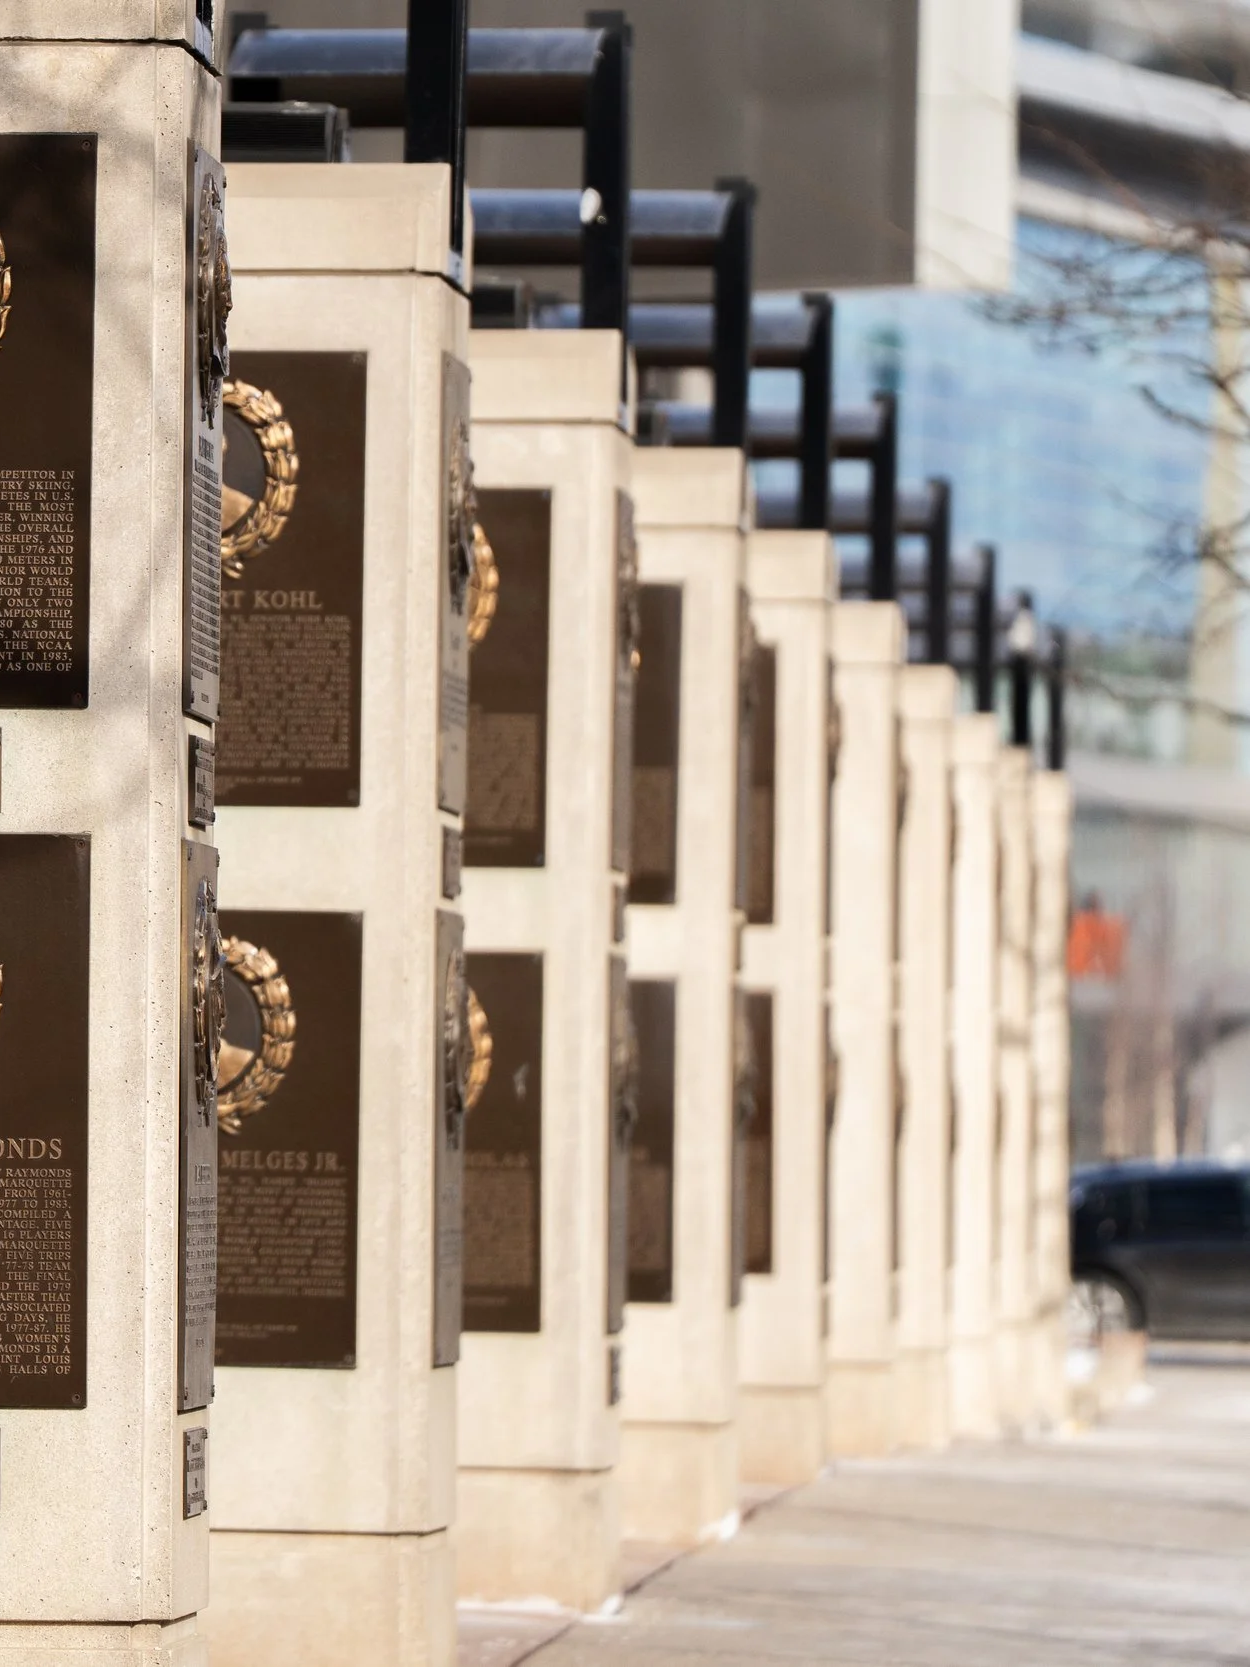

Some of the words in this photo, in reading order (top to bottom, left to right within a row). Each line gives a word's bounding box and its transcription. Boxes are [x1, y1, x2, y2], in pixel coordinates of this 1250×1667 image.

[61, 470, 74, 480] IN
[7, 502, 31, 511] THE
[39, 502, 74, 511] MOST
[48, 534, 73, 543] AND
[7, 555, 55, 564] METERS
[60, 555, 73, 565] IN
[7, 598, 39, 607] ONLY
[45, 598, 72, 607] TWO
[254, 590, 322, 608] KOHL
[22, 619, 37, 628] AS
[49, 619, 72, 628] THE
[21, 651, 34, 660] IN
[220, 1150, 308, 1170] MELGES
[314, 1151, 346, 1172] JR.
[6, 1168, 71, 1177] RAYMONDS
[0, 1179, 72, 1188] MARQUETTE
[4, 1189, 36, 1198] FROM
[6, 1272, 28, 1280] THE
[36, 1272, 70, 1281] FINAL
[16, 1282, 39, 1291] THE
[48, 1282, 70, 1291] 1979
[55, 1324, 70, 1333] HE
[46, 1344, 56, 1353] IS
[35, 1354, 70, 1364] LOUIS
